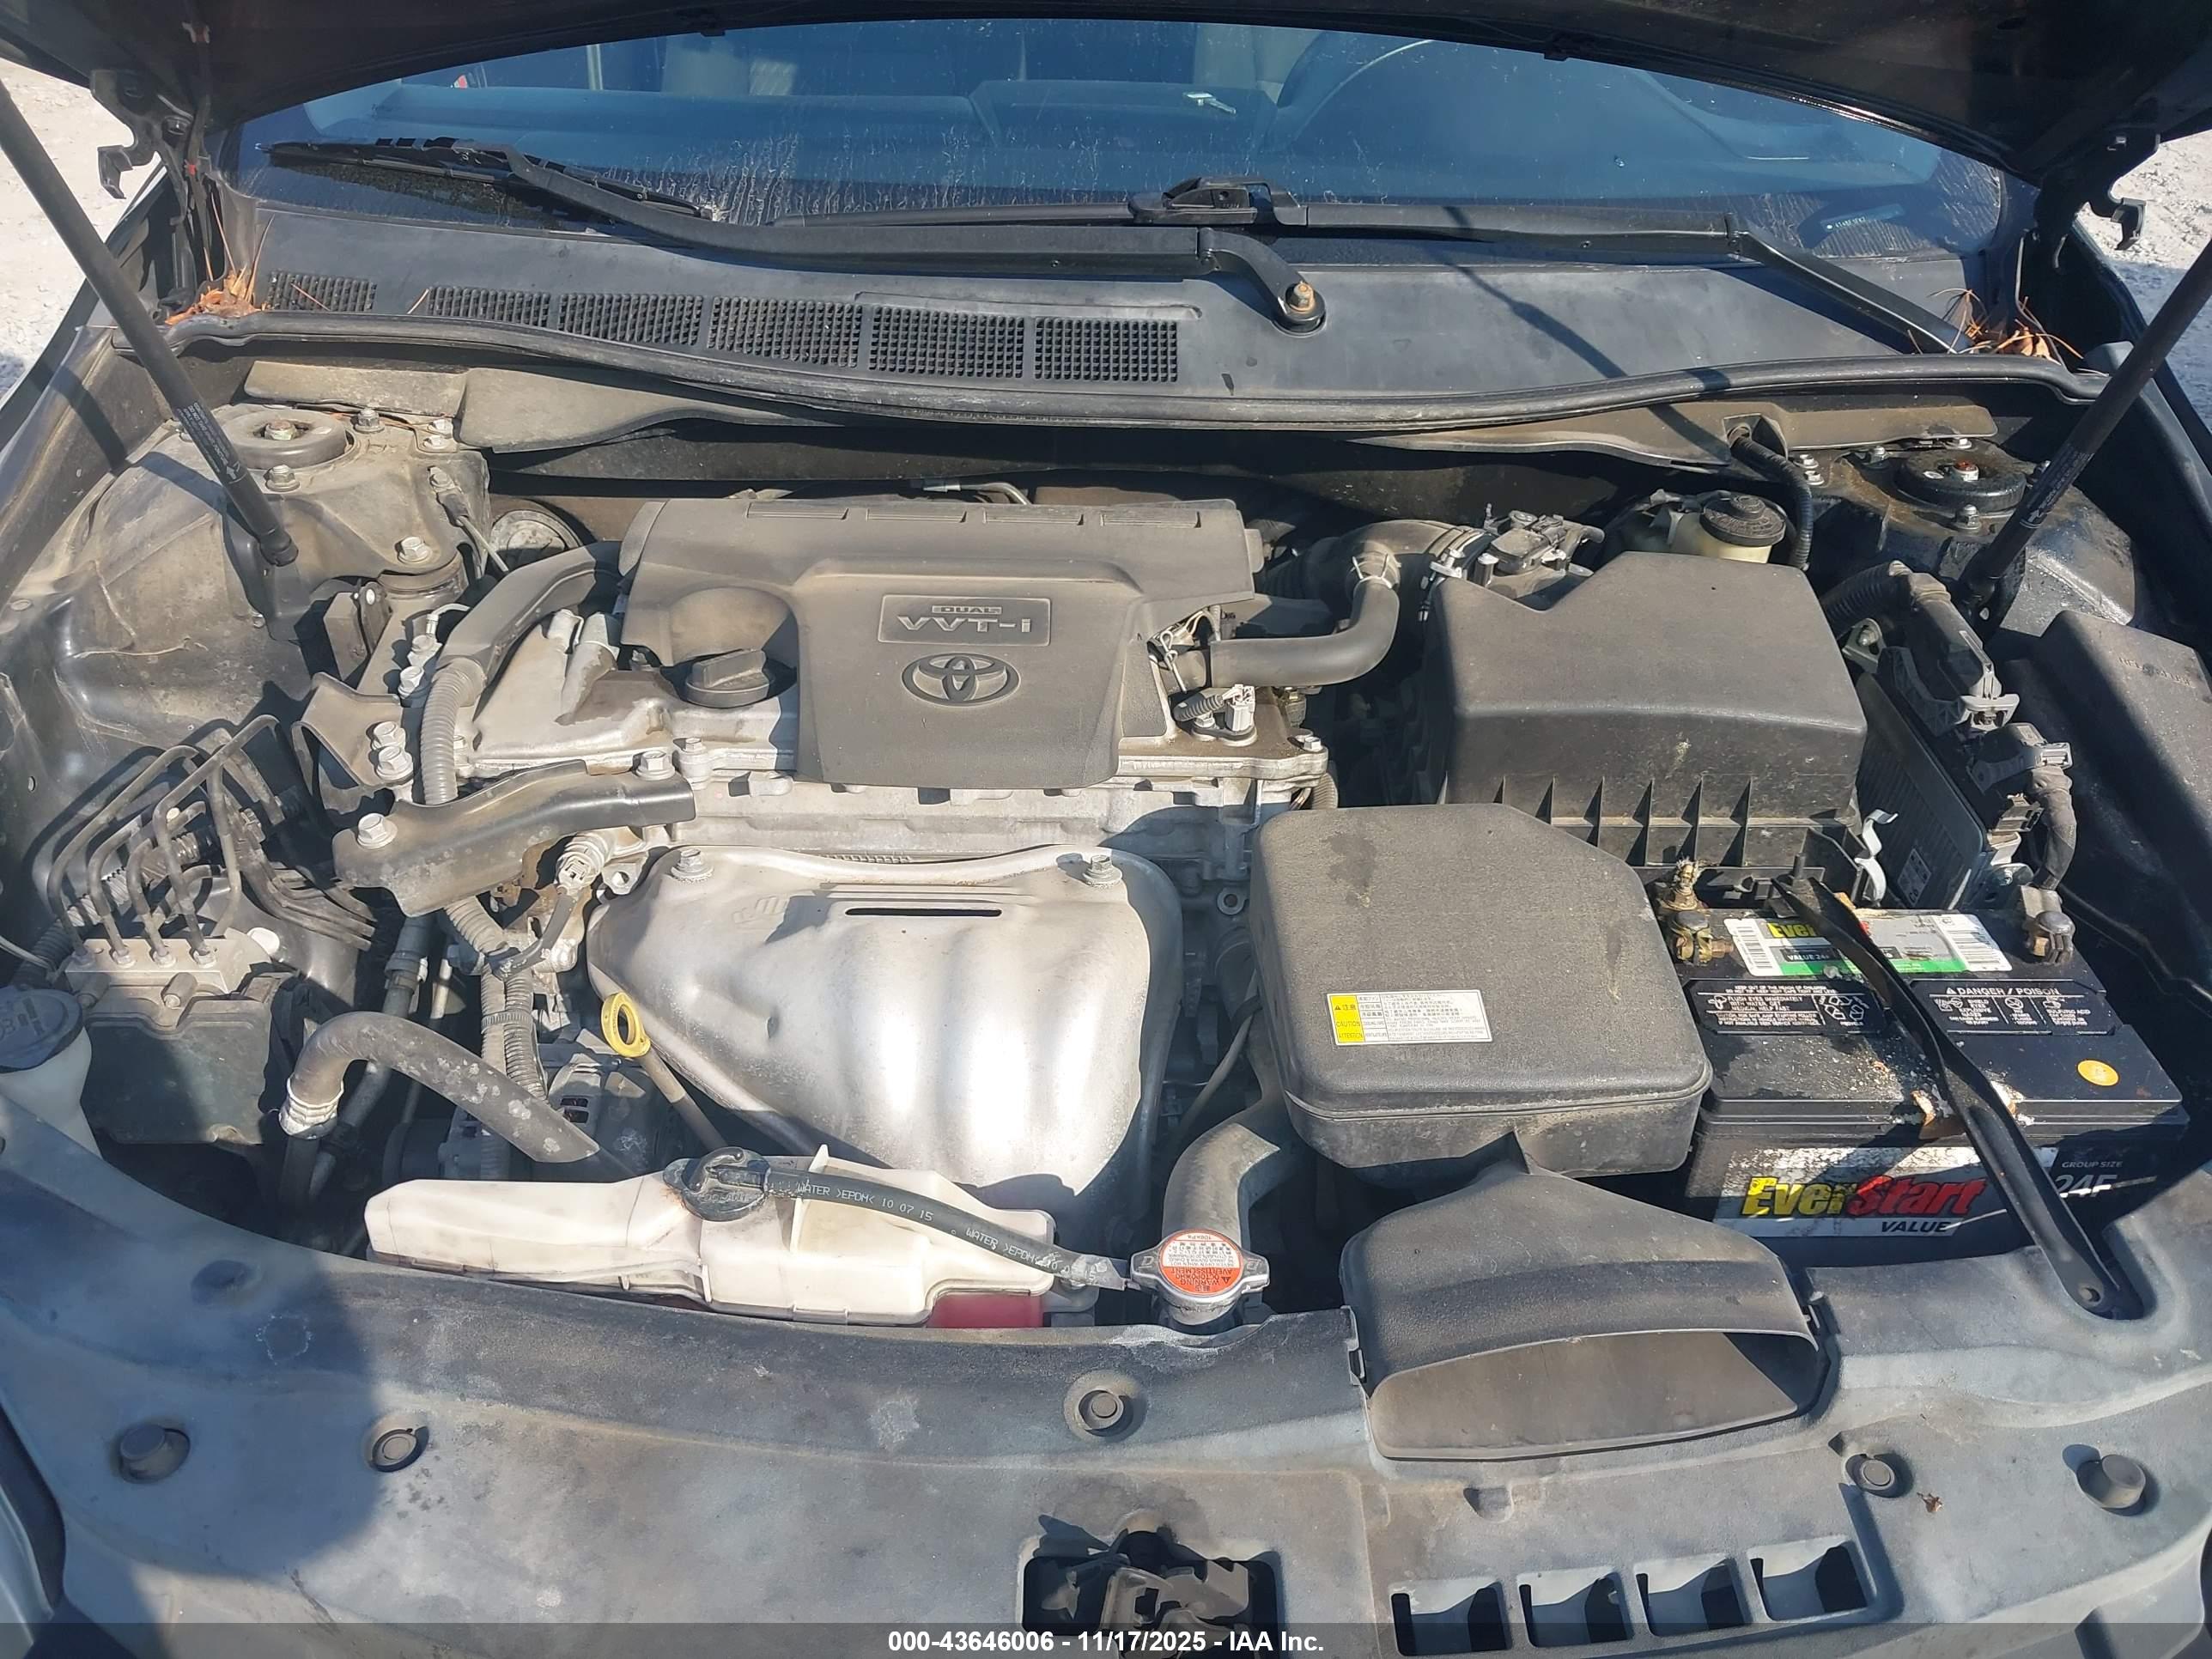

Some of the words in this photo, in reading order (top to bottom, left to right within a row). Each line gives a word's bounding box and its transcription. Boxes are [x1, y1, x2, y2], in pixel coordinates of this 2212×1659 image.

[896, 616, 1031, 632] VVT-i
[797, 1183, 831, 1196] WATER
[881, 1198, 894, 1209] 10
[899, 1203, 915, 1214] 07
[920, 1210, 934, 1222] 15
[1741, 1175, 1987, 1216] EverStart
[1881, 1221, 1952, 1232] VALUE
[966, 1227, 999, 1249] WATER
